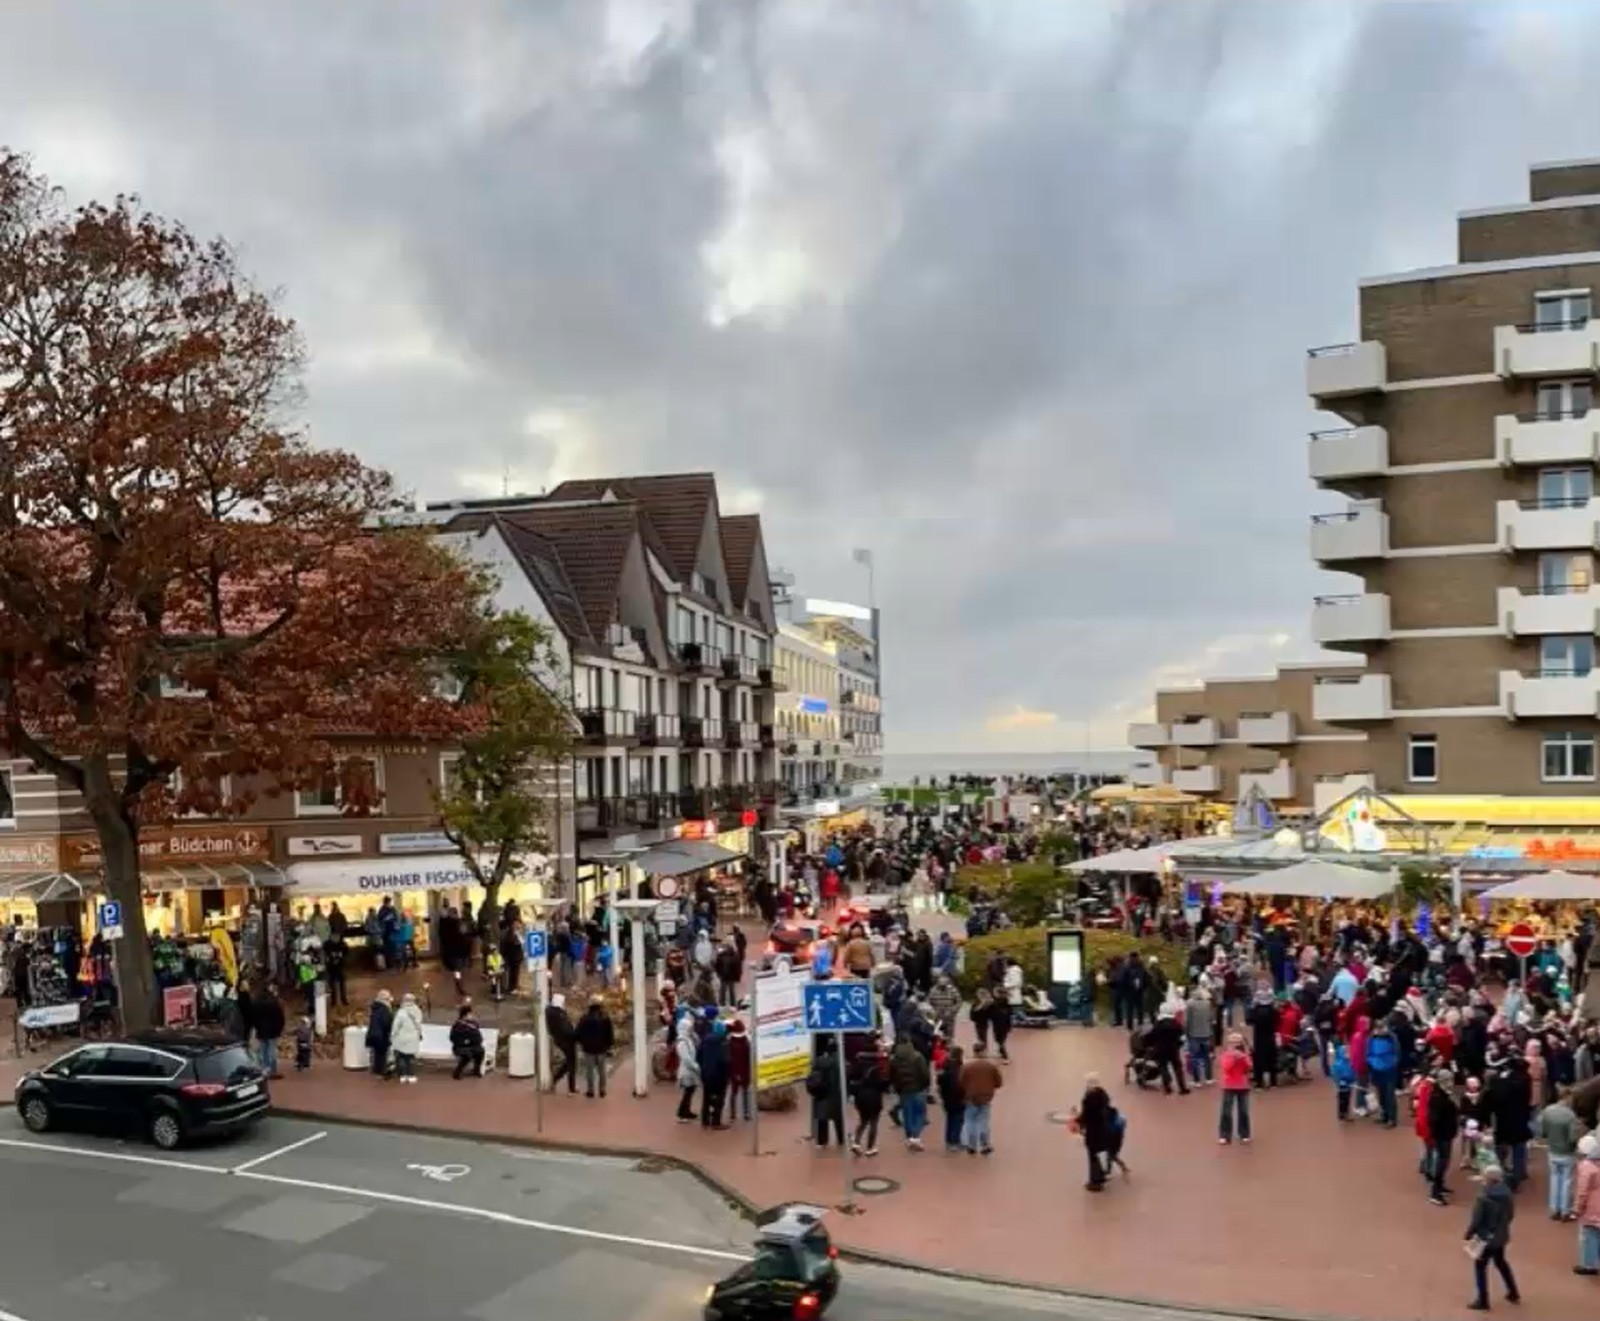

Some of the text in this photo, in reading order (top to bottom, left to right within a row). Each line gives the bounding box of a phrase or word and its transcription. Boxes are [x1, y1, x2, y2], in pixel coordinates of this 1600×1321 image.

[169, 837, 233, 854] Büdchen
[359, 872, 422, 889] DUHNER
[104, 904, 116, 925] P
[531, 934, 541, 954] P
